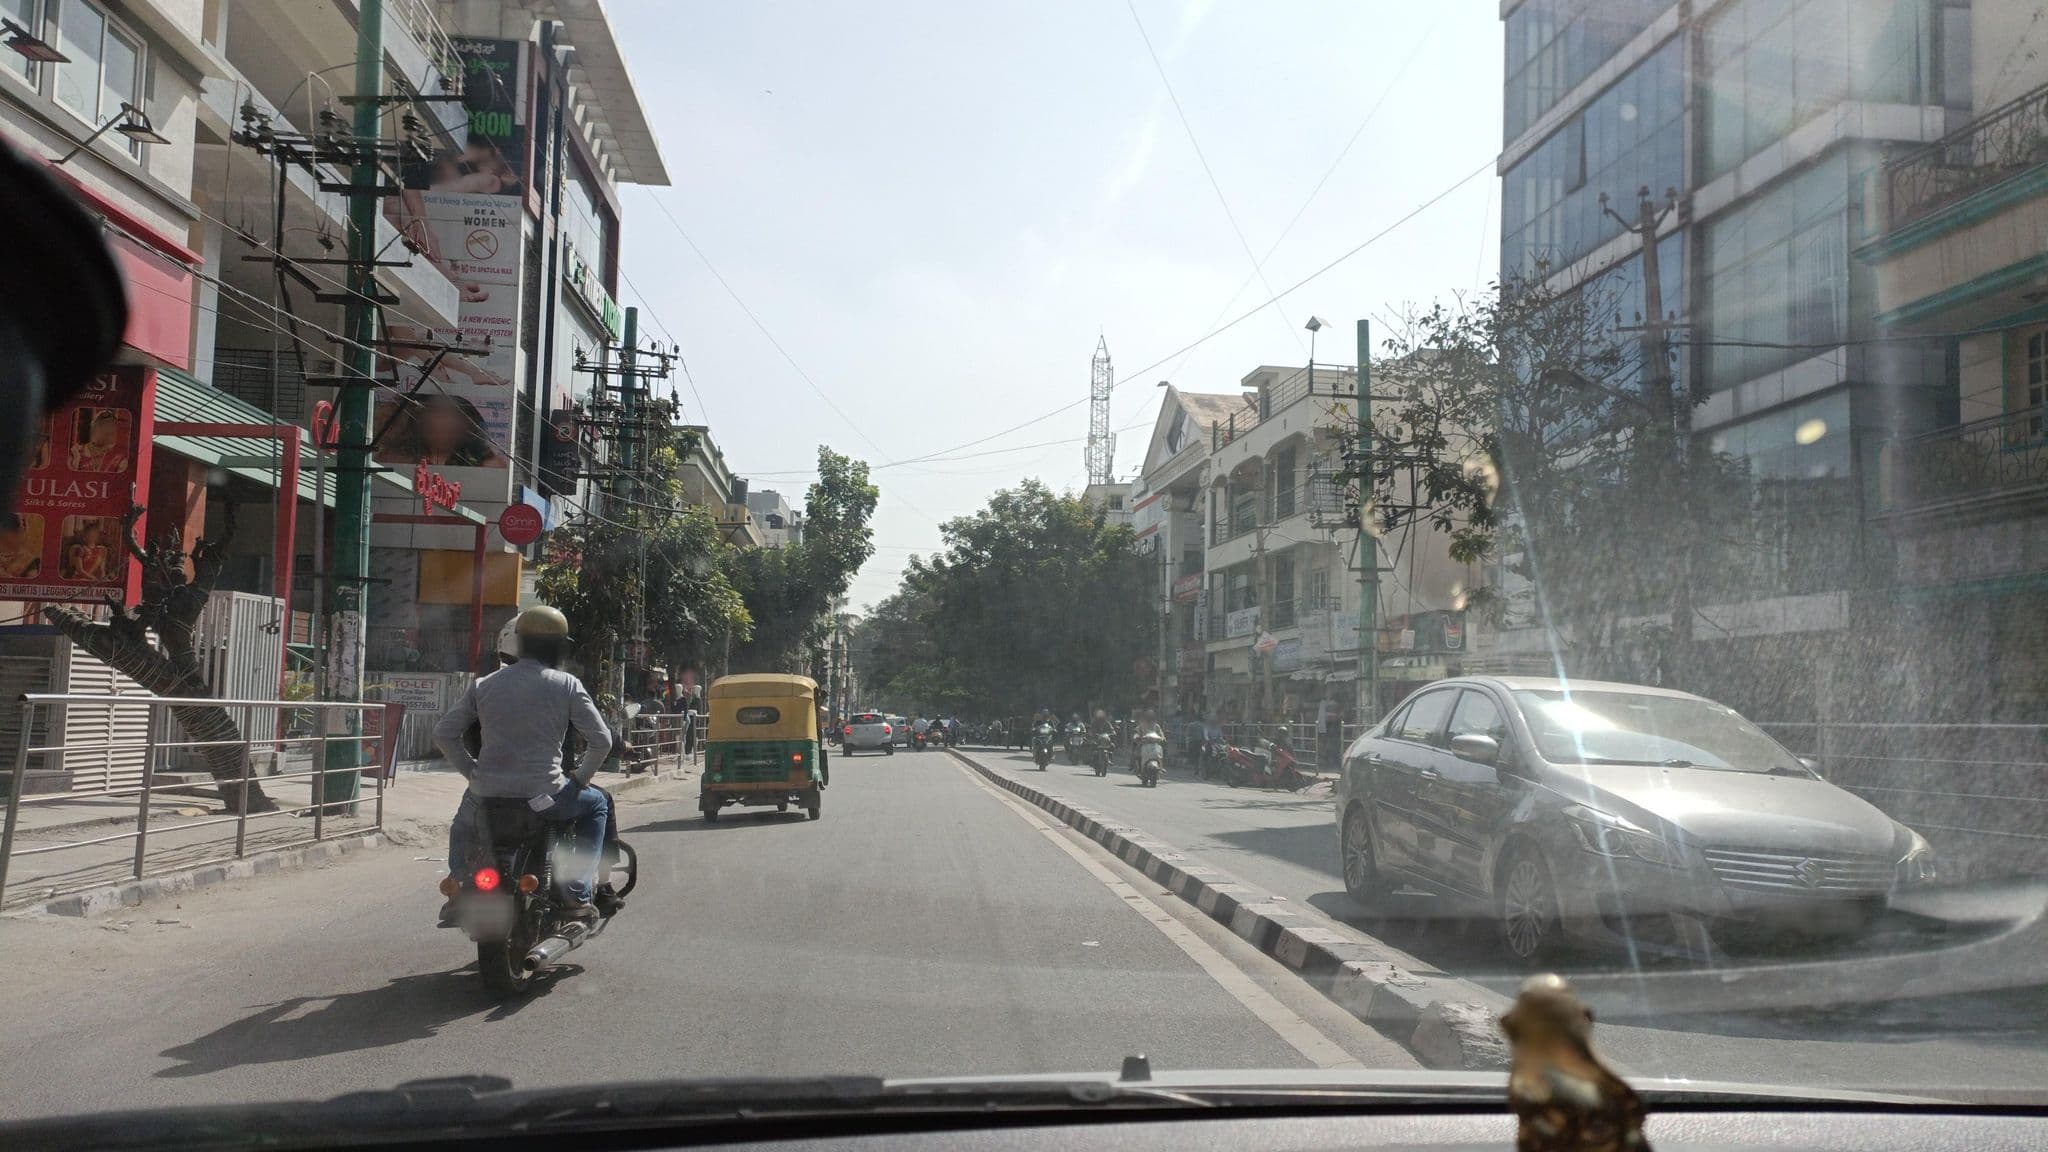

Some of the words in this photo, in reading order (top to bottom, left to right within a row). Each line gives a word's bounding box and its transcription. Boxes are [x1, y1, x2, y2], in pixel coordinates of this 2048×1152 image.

[464, 216, 506, 228] WOMEN
[483, 316, 512, 325] HYGIENIC
[47, 499, 54, 507] &
[12, 585, 38, 595] KURTIS
[42, 586, 76, 597] LEGGINGS
[394, 680, 437, 689] TO-LET
